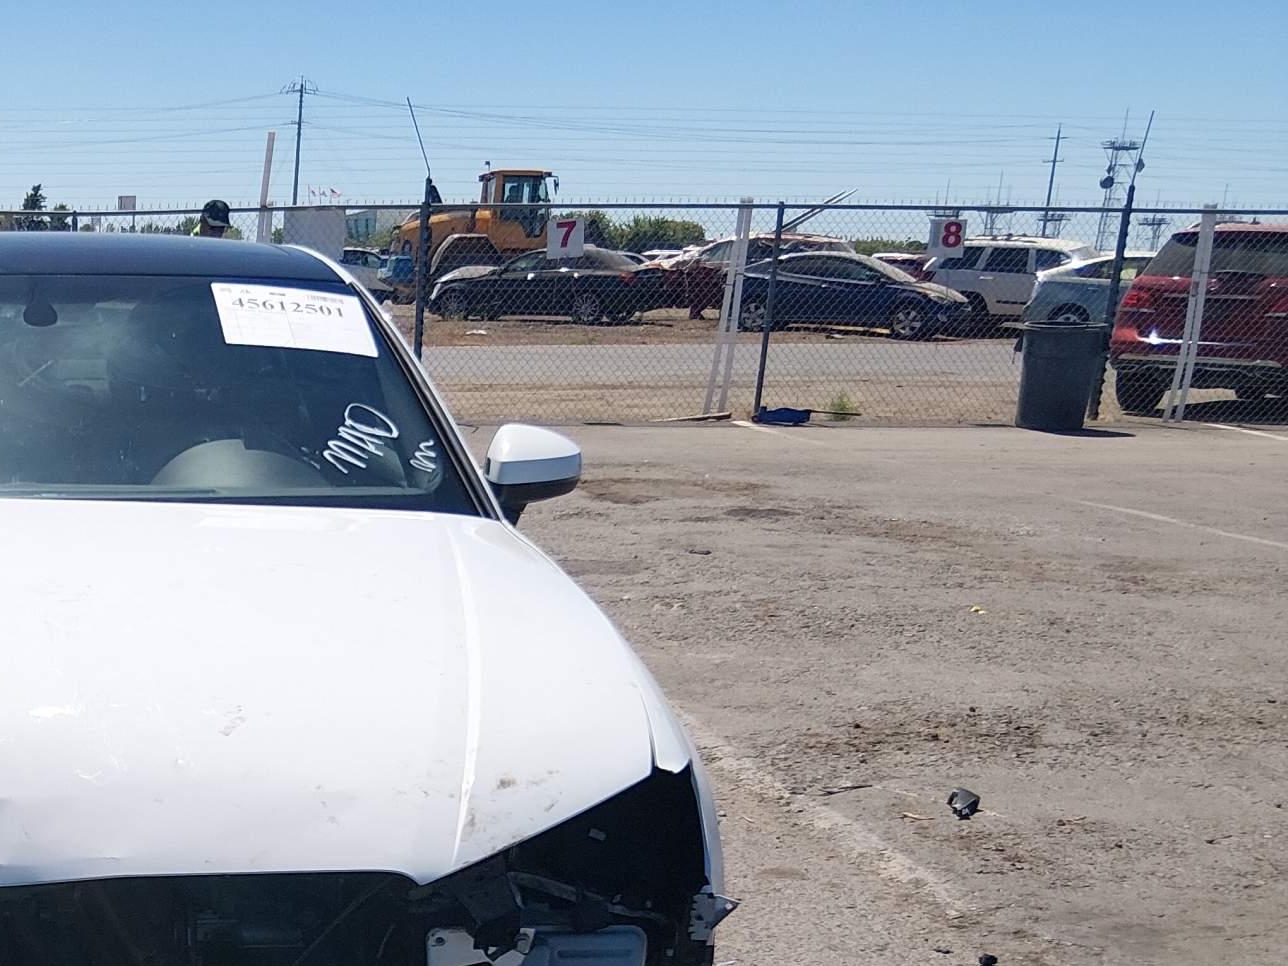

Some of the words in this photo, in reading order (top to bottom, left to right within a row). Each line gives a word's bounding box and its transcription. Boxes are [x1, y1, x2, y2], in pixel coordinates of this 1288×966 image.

[556, 220, 577, 249] 7
[941, 221, 963, 249] 8
[232, 297, 345, 318] 45612501
